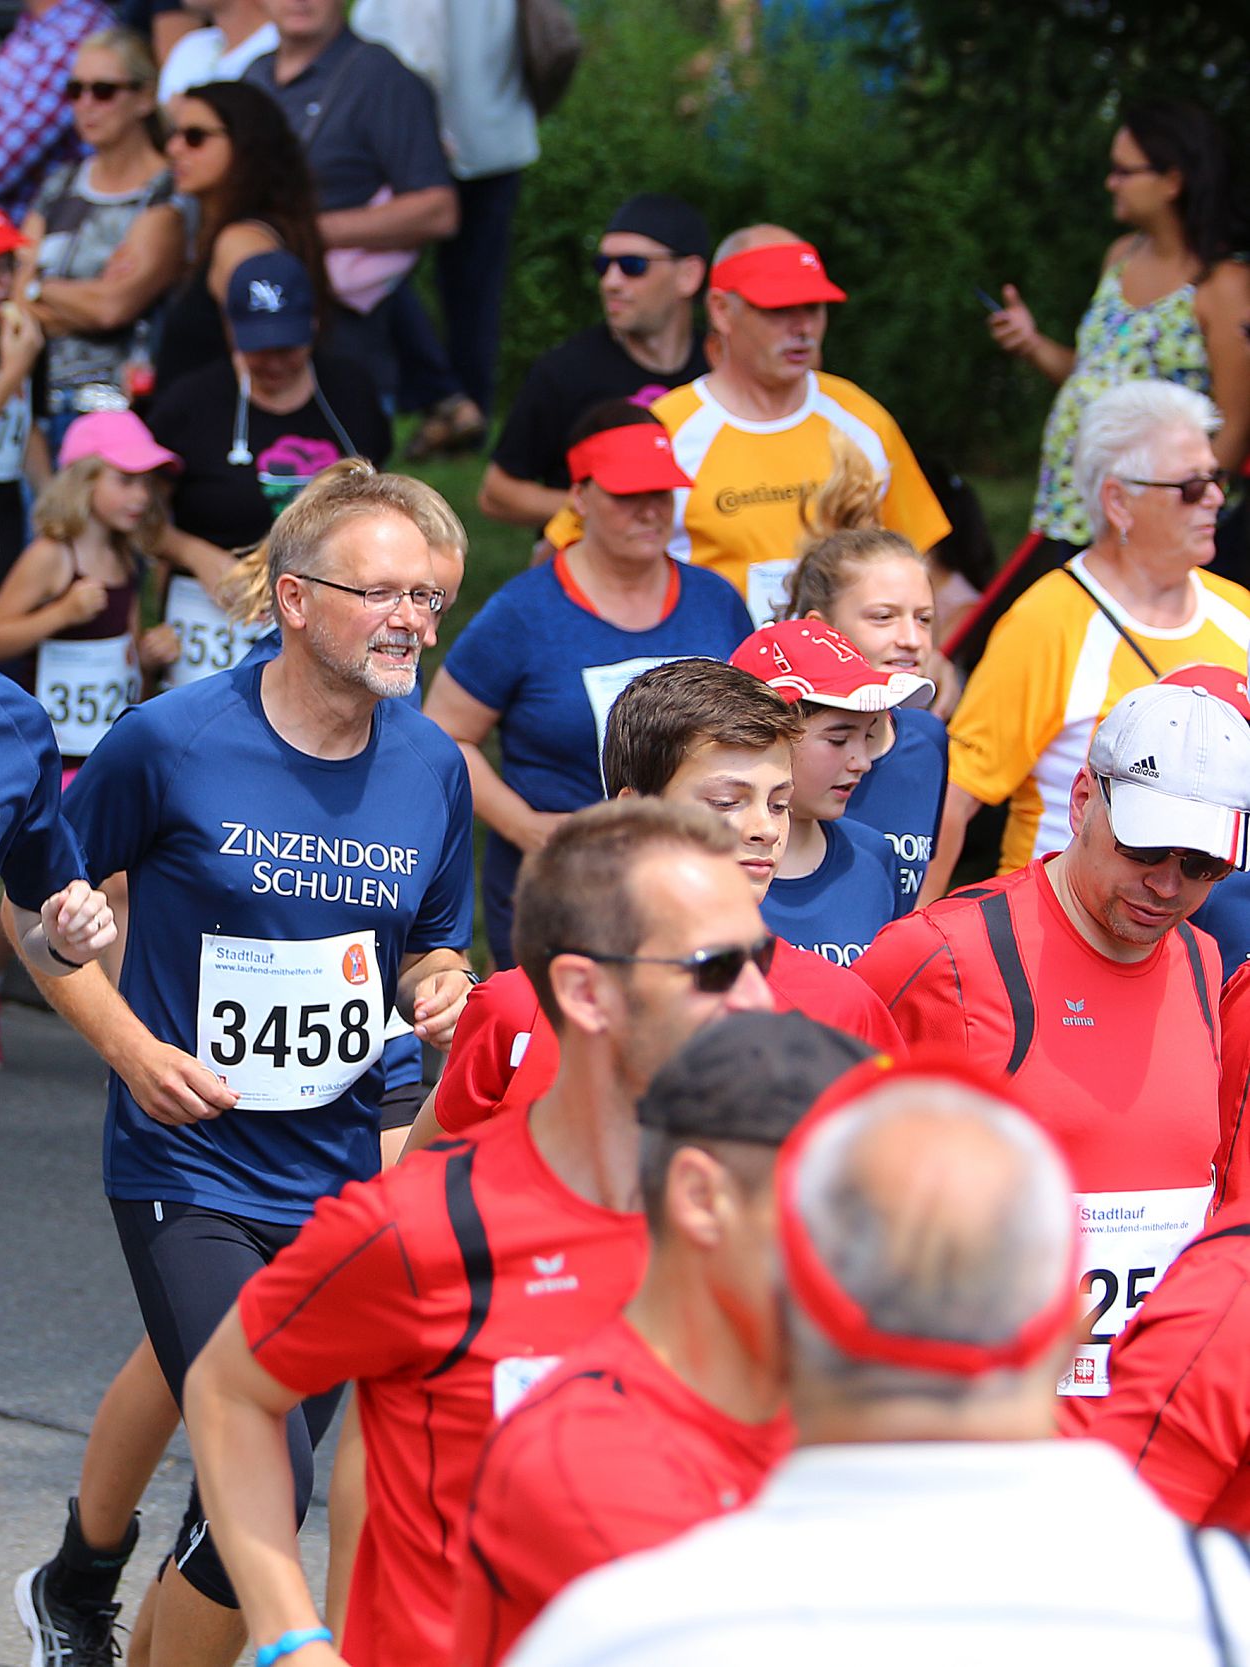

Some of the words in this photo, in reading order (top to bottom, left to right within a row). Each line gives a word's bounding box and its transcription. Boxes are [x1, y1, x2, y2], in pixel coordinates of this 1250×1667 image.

[1128, 765, 1160, 779] adidas
[219, 821, 419, 876] ZINZENDORF
[251, 861, 399, 910] SCHULEN
[216, 946, 275, 965] Stadtlauf
[214, 963, 324, 977] www.laufend-mithelfen.de
[1062, 1015, 1095, 1026] erima
[209, 998, 371, 1069] 3458
[1081, 1206, 1146, 1221] Stadtlauf
